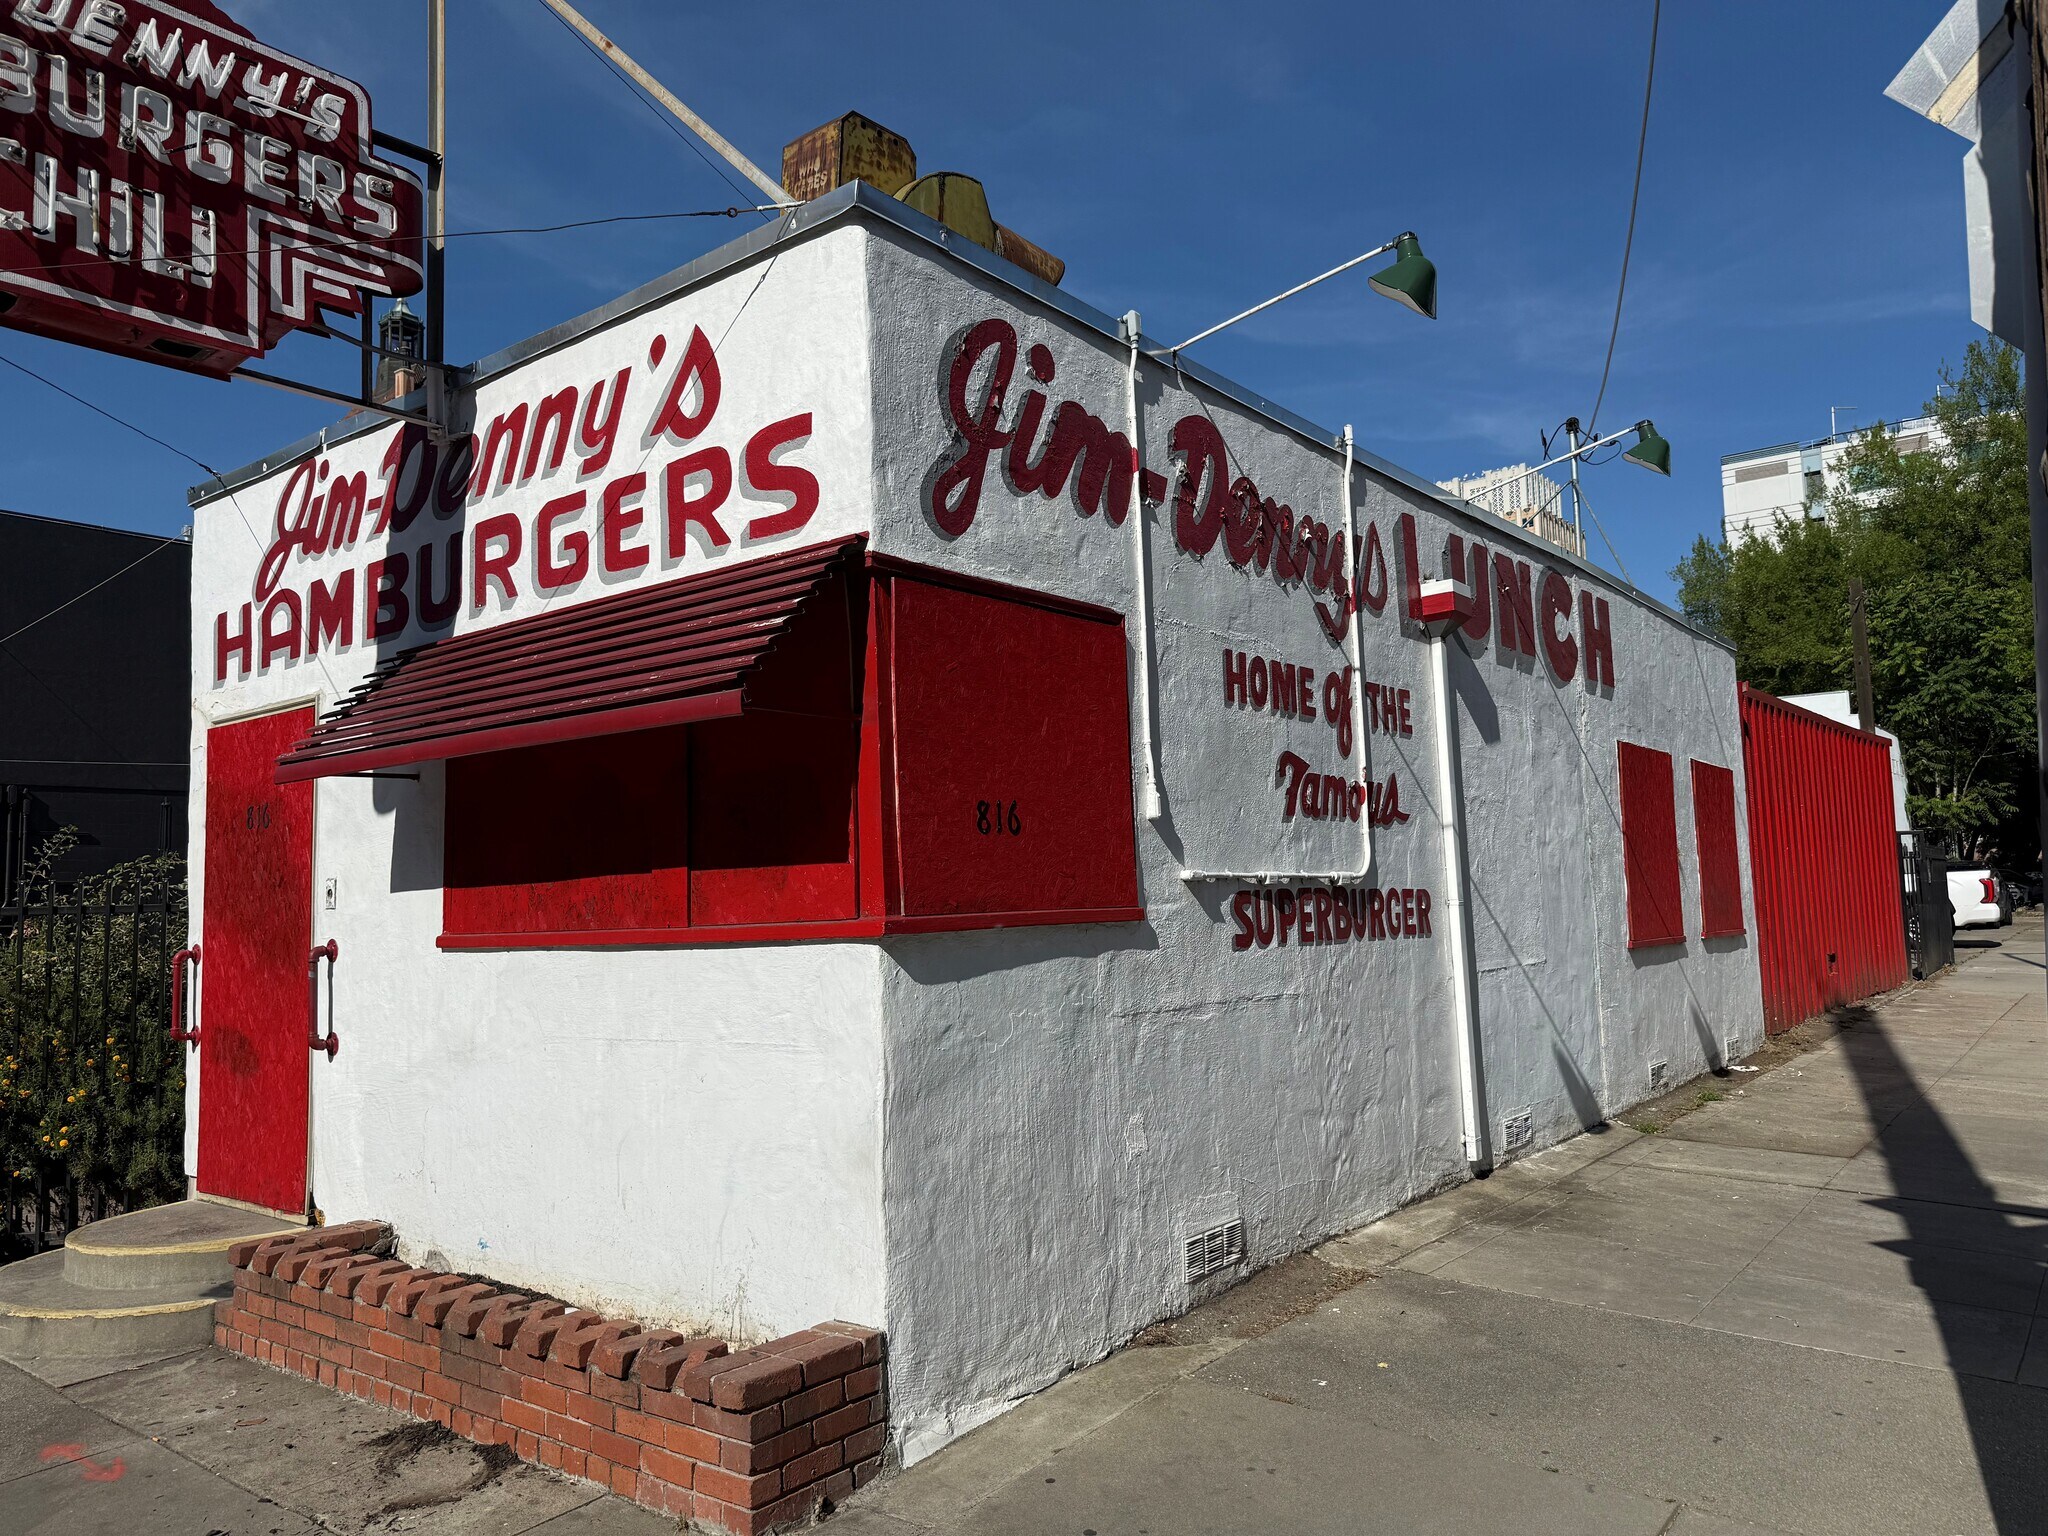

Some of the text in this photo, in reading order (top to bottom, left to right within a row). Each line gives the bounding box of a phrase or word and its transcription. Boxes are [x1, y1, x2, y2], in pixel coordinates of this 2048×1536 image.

[254, 324, 722, 602] Jim-Denny's
[213, 411, 820, 690] HAMBURGERS
[1396, 512, 1616, 698] LUNCH
[1223, 648, 1317, 720] HOME
[1364, 681, 1413, 738] THE
[247, 804, 270, 829] 816
[976, 799, 1022, 836] 816
[1276, 750, 1411, 828] Famous
[1233, 887, 1432, 951] SUPERBURGER
